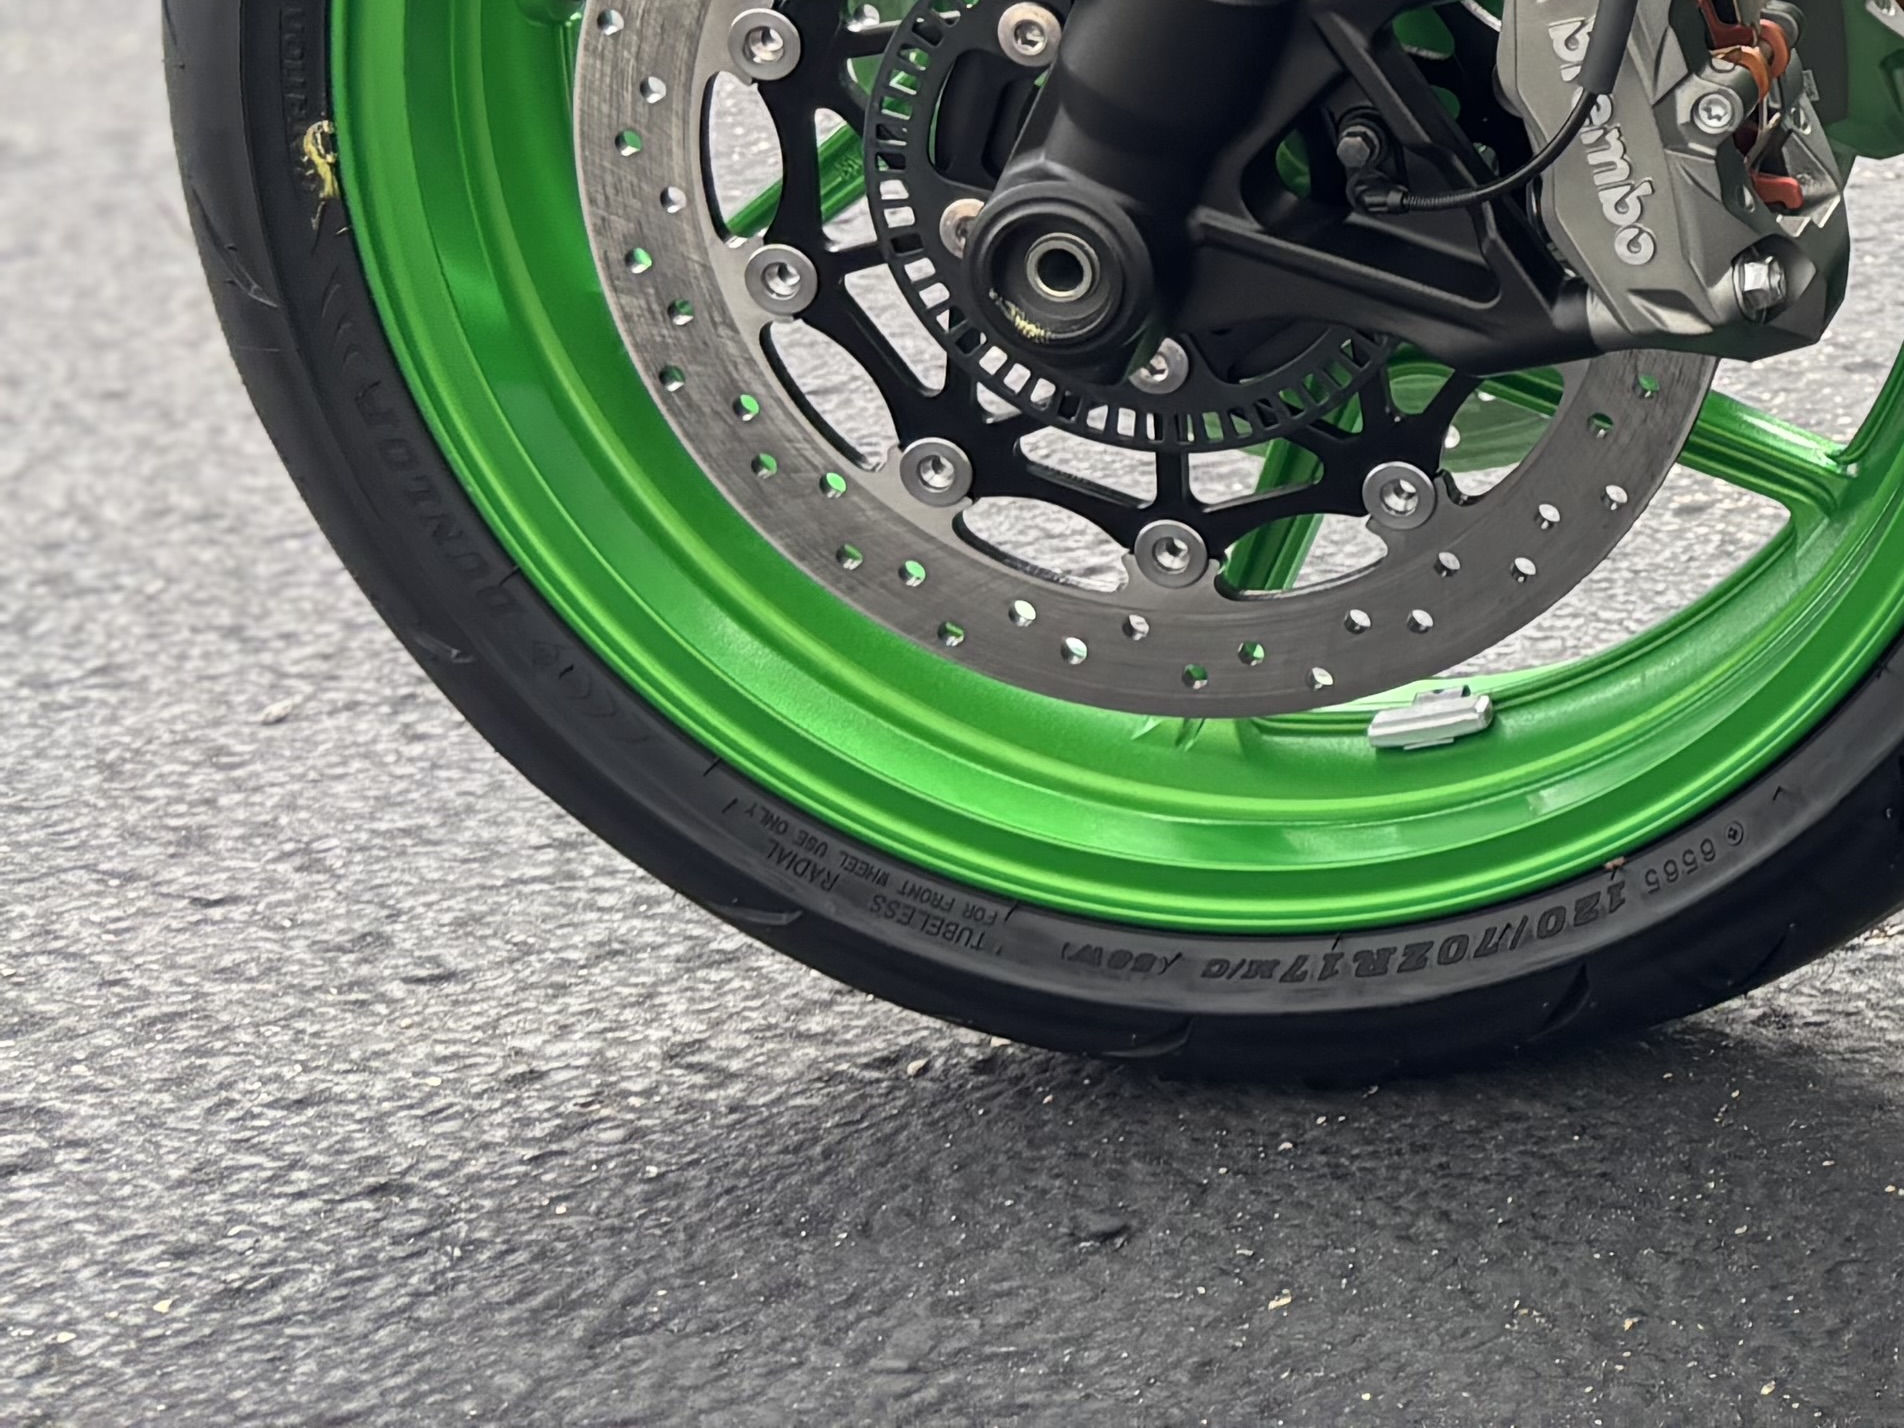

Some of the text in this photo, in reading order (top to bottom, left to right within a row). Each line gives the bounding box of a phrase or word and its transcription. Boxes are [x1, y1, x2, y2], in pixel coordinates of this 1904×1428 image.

[742, 799, 998, 927] FOR FRONT WHEEL USE ONLY
[758, 837, 986, 952] TUBELESS RADIAL
[1638, 836, 1722, 894] 6565
